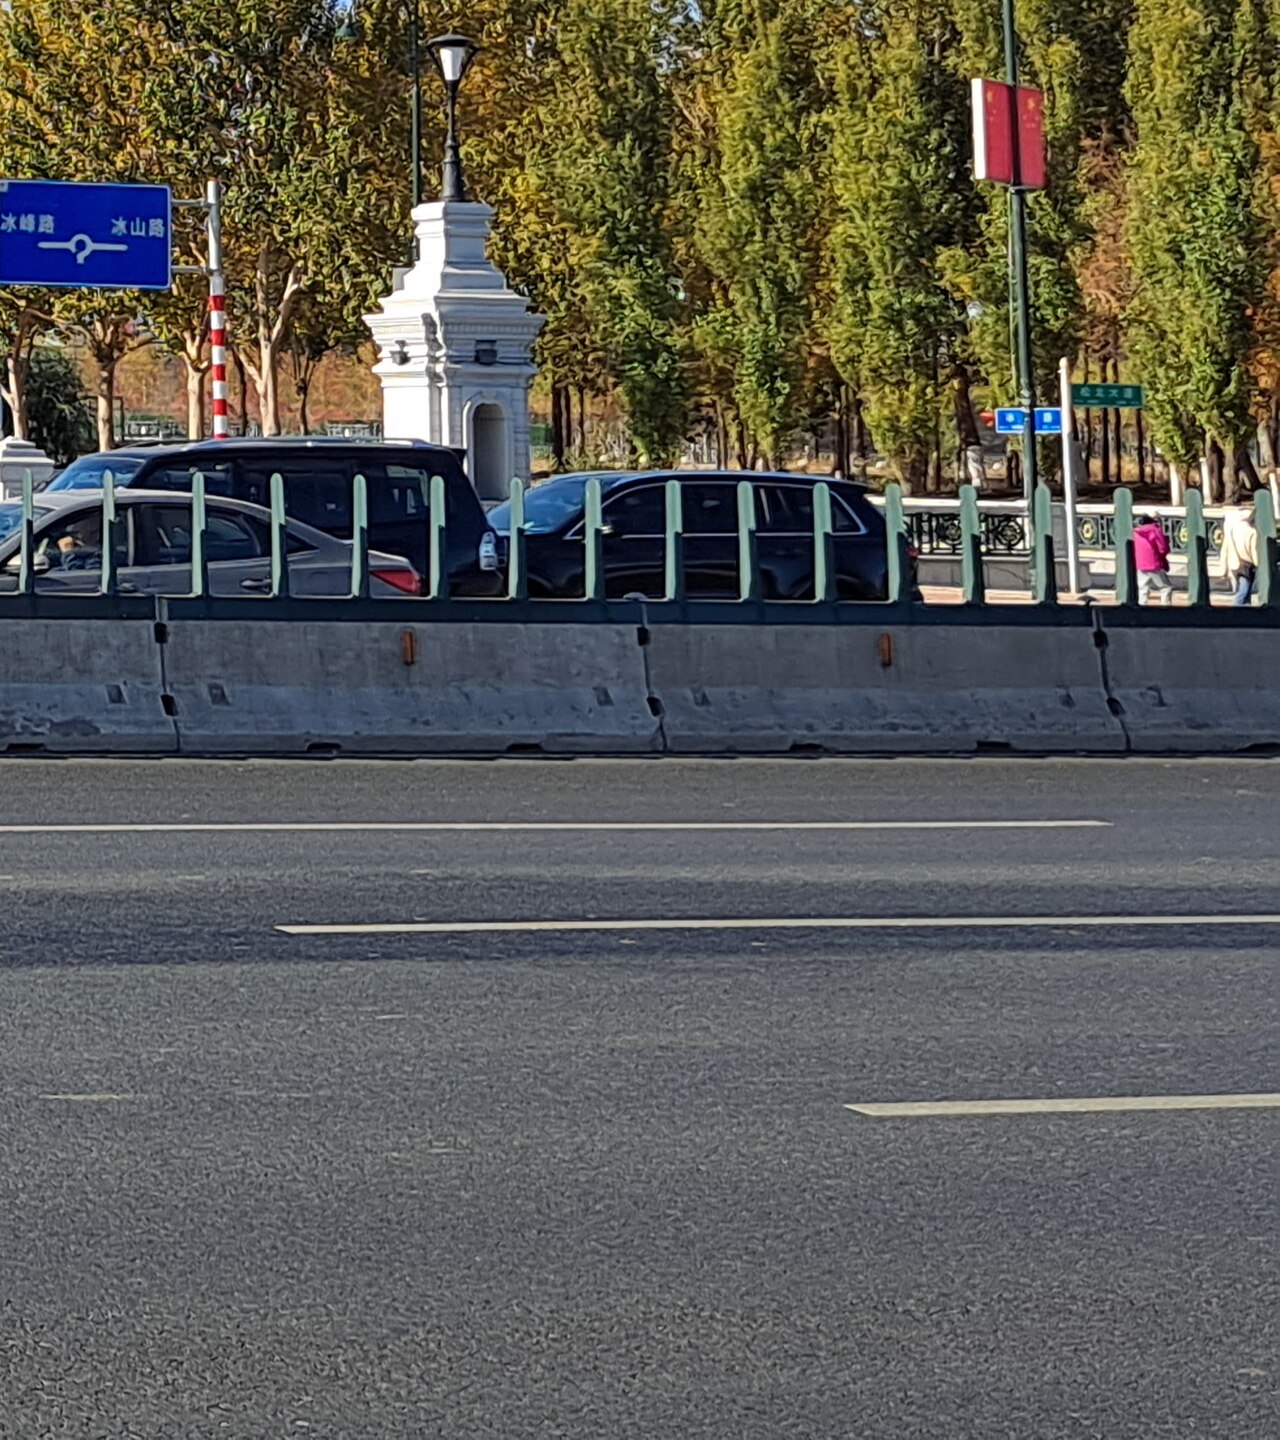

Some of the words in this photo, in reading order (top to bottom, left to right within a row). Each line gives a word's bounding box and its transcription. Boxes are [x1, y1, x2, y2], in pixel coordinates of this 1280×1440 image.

[0, 213, 56, 234] 冰峰路
[110, 216, 166, 238] 冰山路
